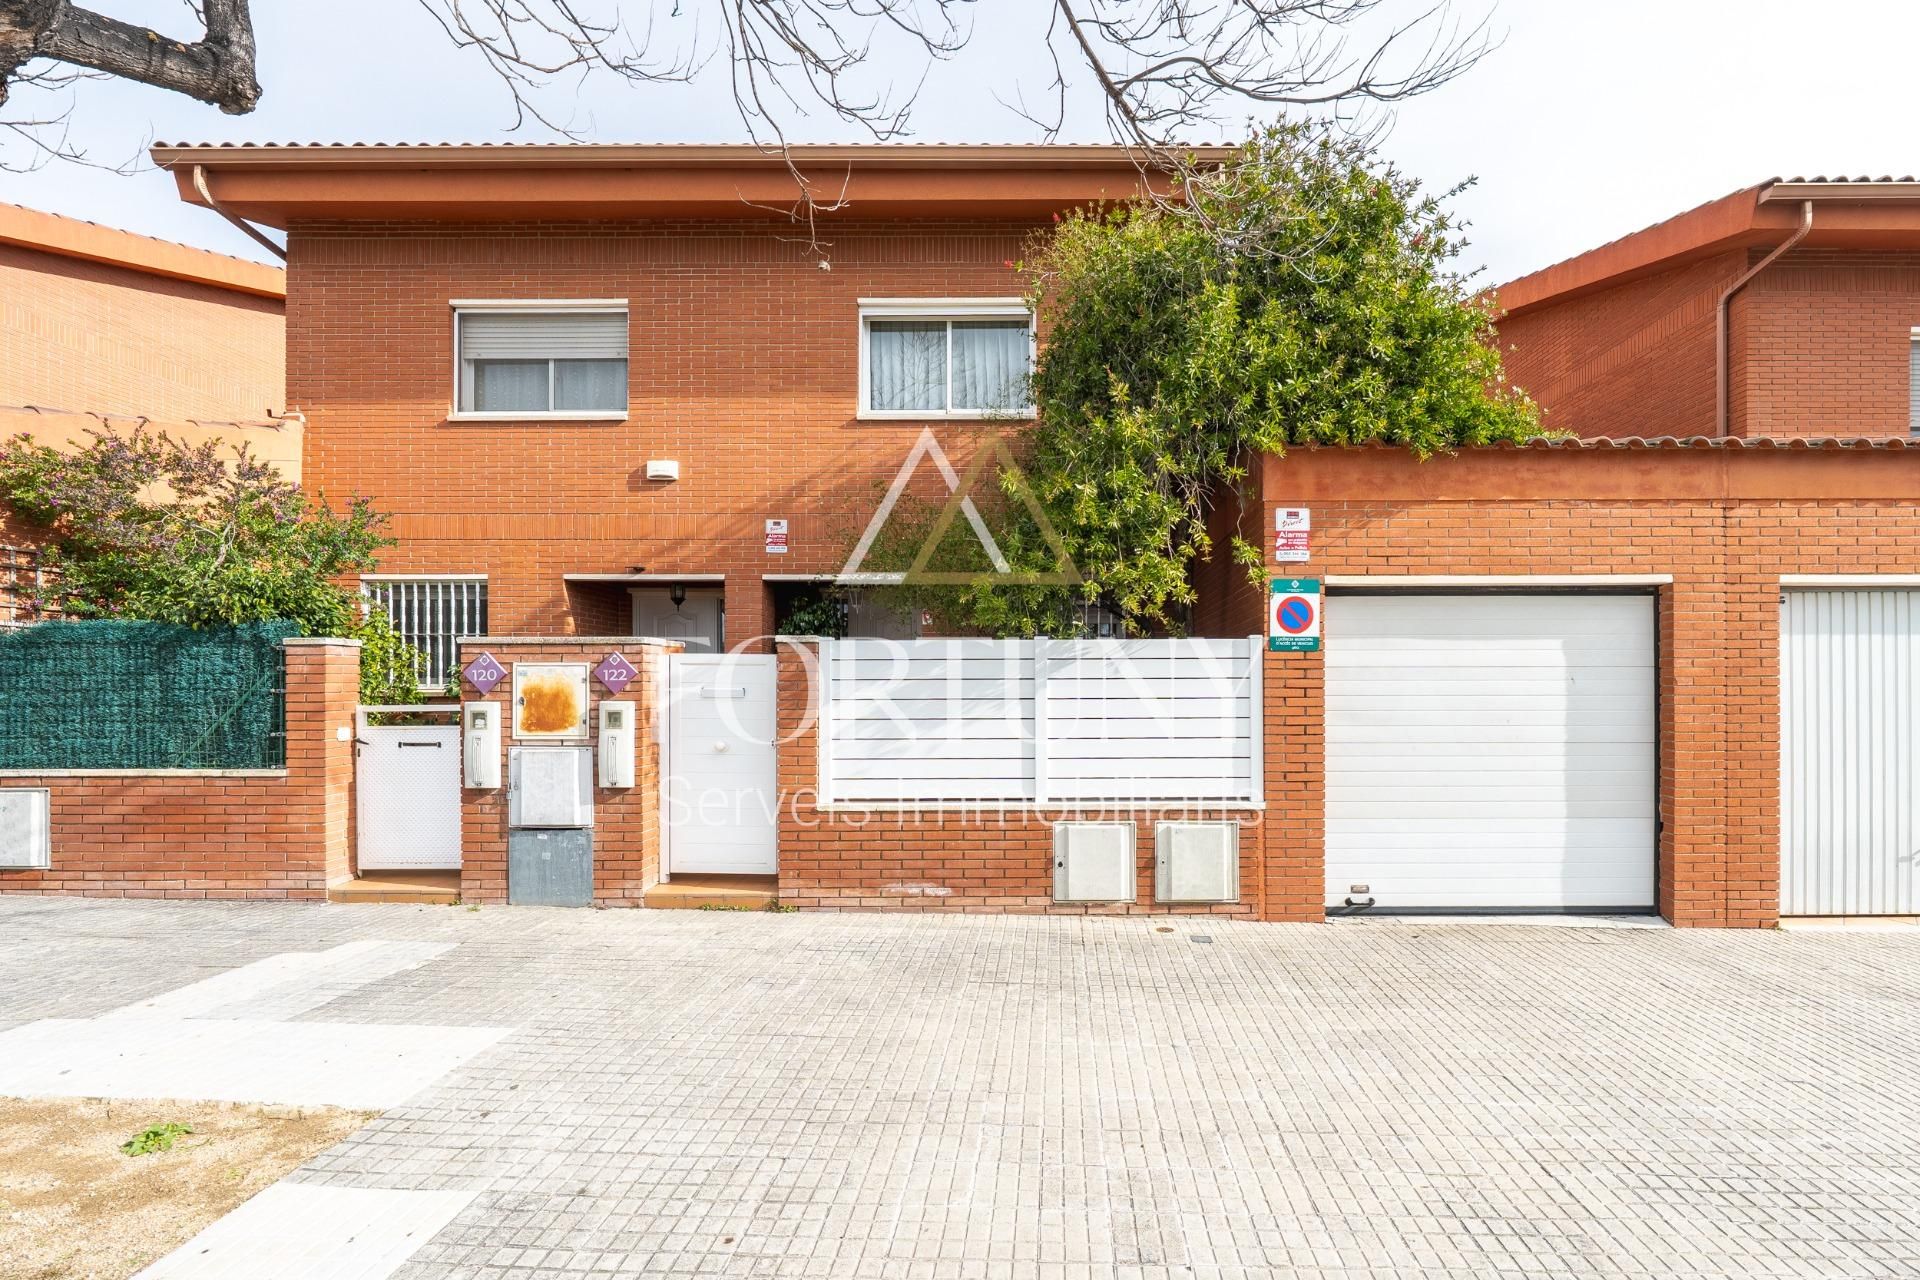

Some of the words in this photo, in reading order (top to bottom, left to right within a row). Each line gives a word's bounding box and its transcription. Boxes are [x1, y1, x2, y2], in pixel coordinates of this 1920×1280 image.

[1279, 530, 1308, 538] Alarma
[472, 669, 497, 681] 120
[603, 669, 628, 681] 122
